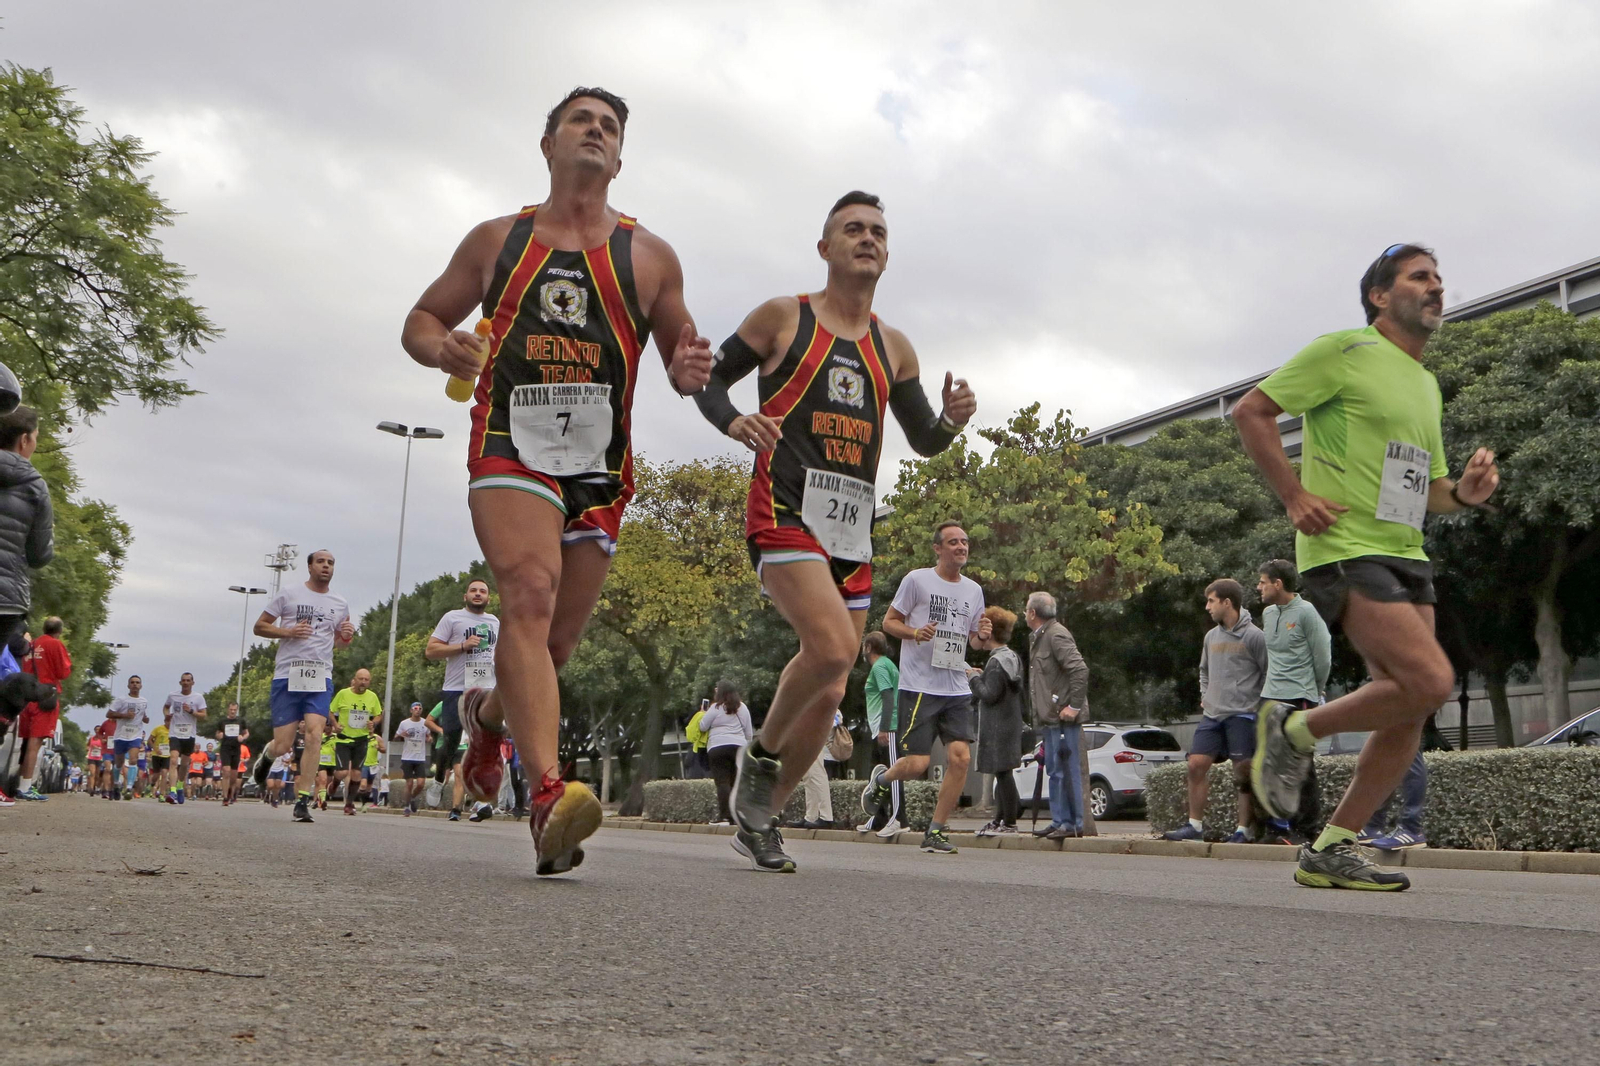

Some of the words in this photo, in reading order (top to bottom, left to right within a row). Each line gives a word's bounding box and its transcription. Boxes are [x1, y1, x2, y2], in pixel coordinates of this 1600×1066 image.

[526, 335, 601, 368] RETINTO
[540, 364, 592, 384] TEAM
[513, 386, 550, 407] XXXIX
[552, 386, 582, 397] CARRERA
[552, 396, 578, 405] CIUDAD
[582, 396, 590, 405] DE
[556, 412, 572, 437] 7
[812, 411, 873, 444] RETINTO
[823, 438, 863, 466] TEAM
[809, 472, 842, 493] XXXIX
[1402, 468, 1427, 496] 581
[826, 498, 859, 526] 218
[928, 612, 948, 623] POPULAR
[944, 641, 963, 655] 270
[299, 668, 317, 679] 162
[472, 669, 487, 678] 595
